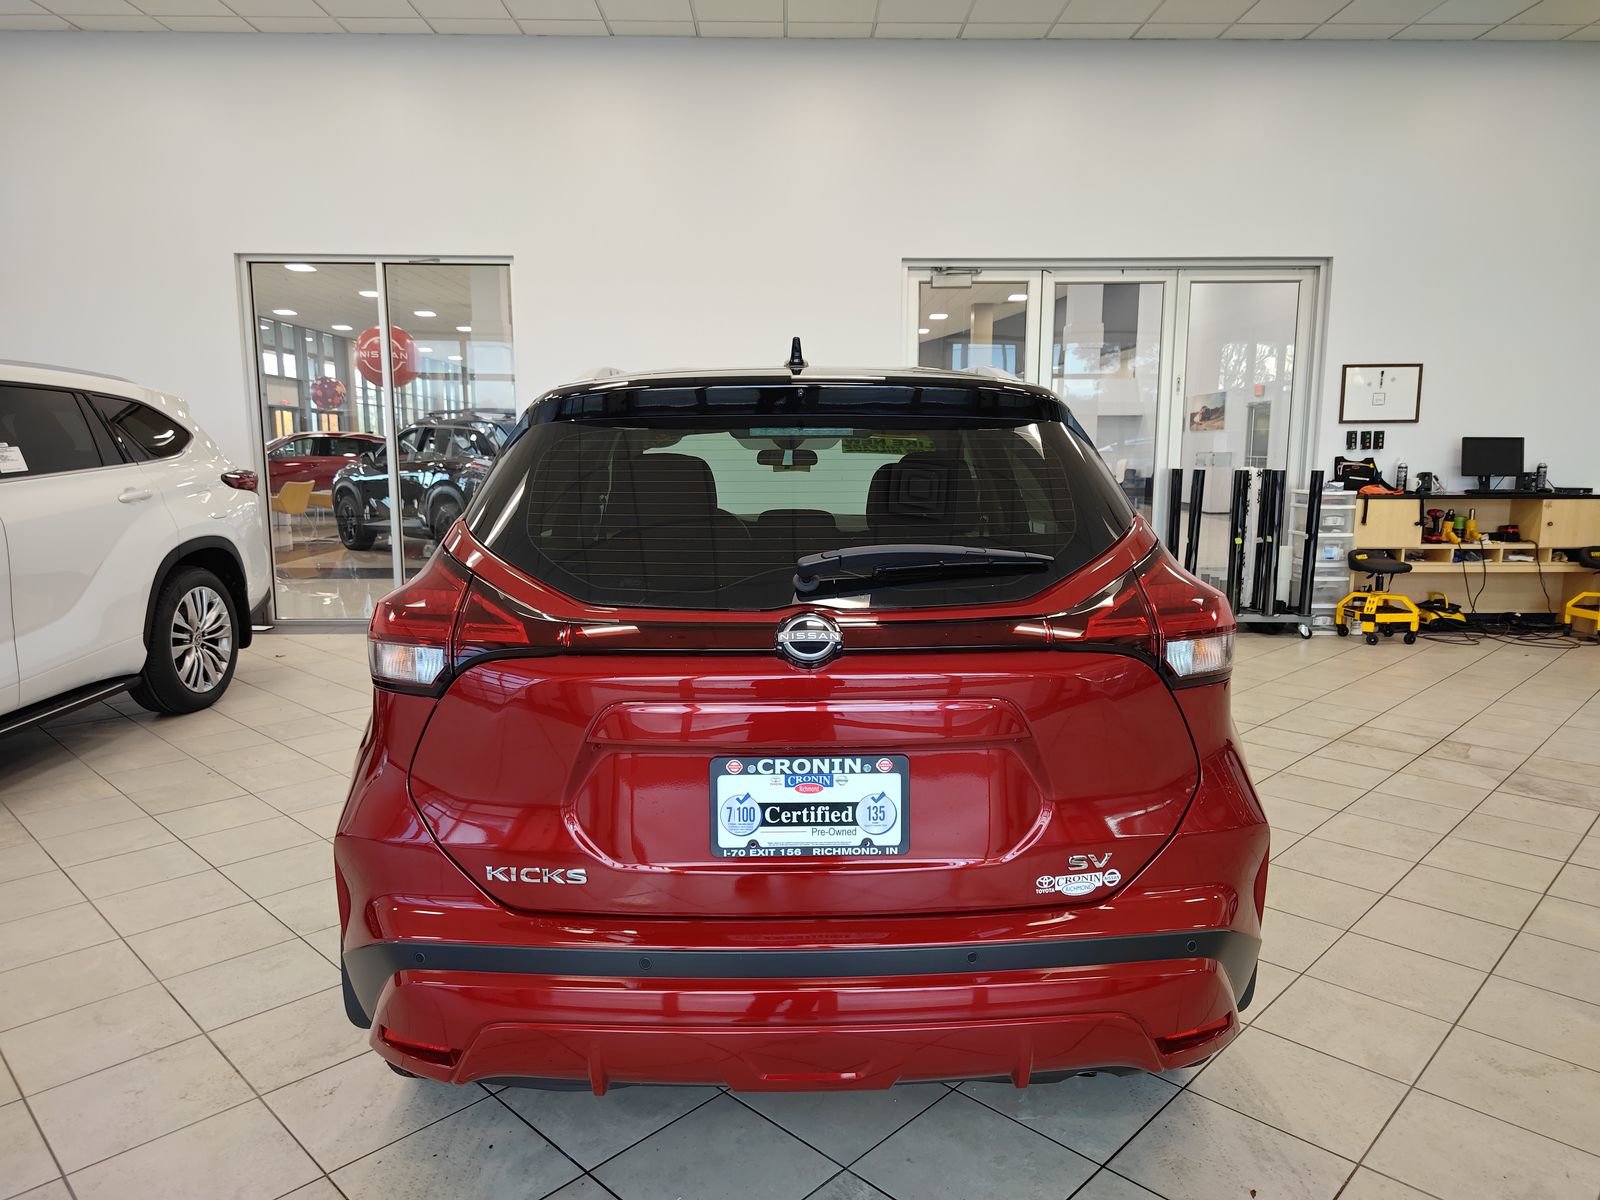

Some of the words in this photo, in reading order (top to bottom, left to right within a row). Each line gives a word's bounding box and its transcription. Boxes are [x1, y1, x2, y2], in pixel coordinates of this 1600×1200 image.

[359, 350, 408, 360] NISAN
[780, 632, 840, 641] NISSAN
[756, 758, 862, 775] CRONIN
[787, 775, 831, 786] CRONIN
[764, 806, 854, 823] Certified
[866, 805, 886, 822] 135
[811, 827, 857, 837] Pre-Owned
[723, 849, 746, 857] I-70
[749, 848, 775, 857] EXIT
[812, 847, 882, 856] RICHMOND,
[885, 847, 898, 855] IN
[1068, 852, 1112, 870] SV
[485, 865, 588, 885] KICKS
[1057, 874, 1101, 887] CRONIN
